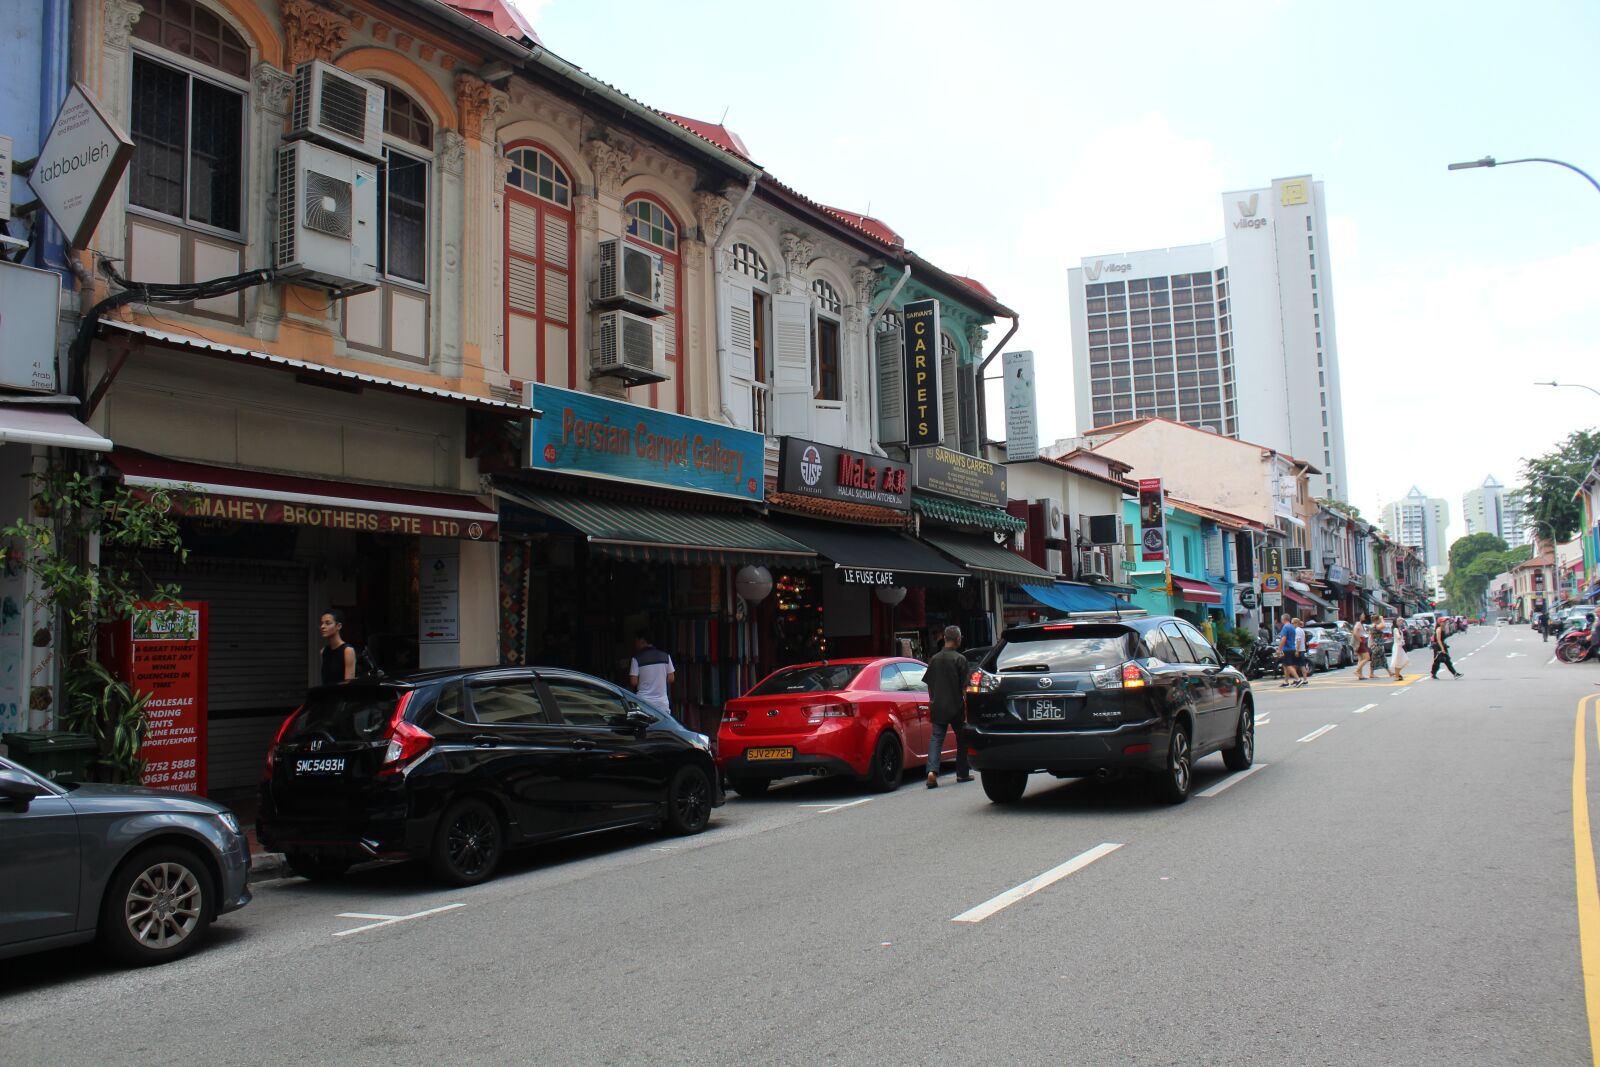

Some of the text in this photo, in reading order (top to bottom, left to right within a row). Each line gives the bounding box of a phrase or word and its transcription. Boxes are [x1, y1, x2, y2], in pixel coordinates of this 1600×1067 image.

[40, 141, 109, 183] tabbouleh
[1233, 218, 1268, 230] village
[1104, 263, 1132, 273] village
[906, 309, 933, 319] SARVAN'S
[32, 371, 51, 380] Arab
[914, 322, 928, 435] CARPETS
[32, 380, 53, 389] Street
[562, 407, 744, 485] Persian Carpet Gallery
[935, 448, 966, 468] SARVAN'S
[966, 458, 994, 476] CARPETS
[839, 453, 879, 491] MaLa
[838, 486, 855, 497] HALAL
[877, 492, 896, 503] KITCHEN
[194, 498, 460, 536] MAHEY BROTHERS PTE LTD
[844, 569, 894, 585] LE FUSE CAFE
[957, 577, 965, 588] 47
[1036, 700, 1057, 709] SGL
[1032, 709, 1061, 719] 1541C
[170, 728, 195, 736] RETAIL
[748, 749, 792, 760] SJV2772H
[145, 759, 196, 772] 6752 5888
[296, 758, 345, 771] SMC5493H
[144, 770, 196, 784] 9636 4348
